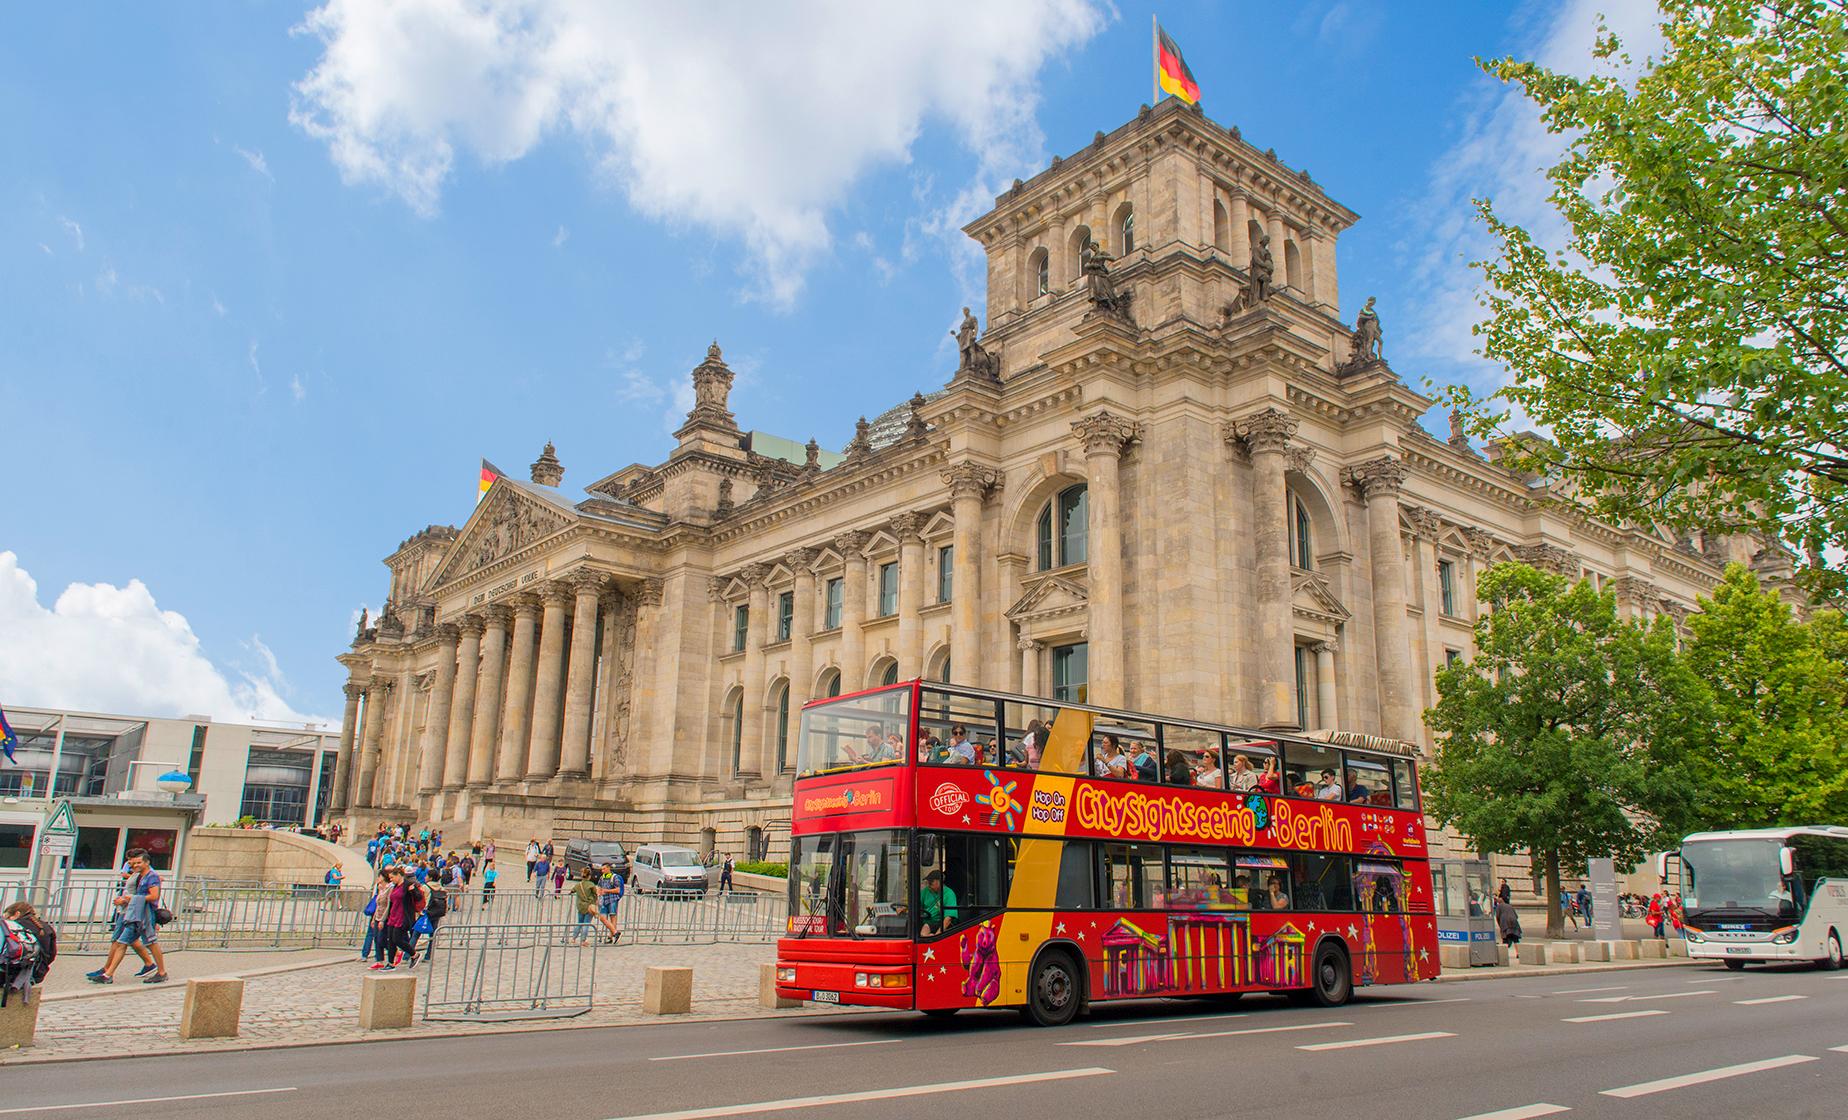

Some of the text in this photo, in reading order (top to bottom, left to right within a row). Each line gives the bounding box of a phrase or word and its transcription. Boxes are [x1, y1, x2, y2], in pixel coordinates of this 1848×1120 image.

[854, 789, 881, 807] Berlin
[934, 793, 967, 807] OFFICIAL
[1034, 790, 1066, 806] Hop On
[944, 803, 959, 813] TOUR
[1032, 806, 1065, 823] Hop Off
[1077, 783, 1353, 852] CitySightseeing Berlin
[1438, 931, 1460, 940] OLIZEI
